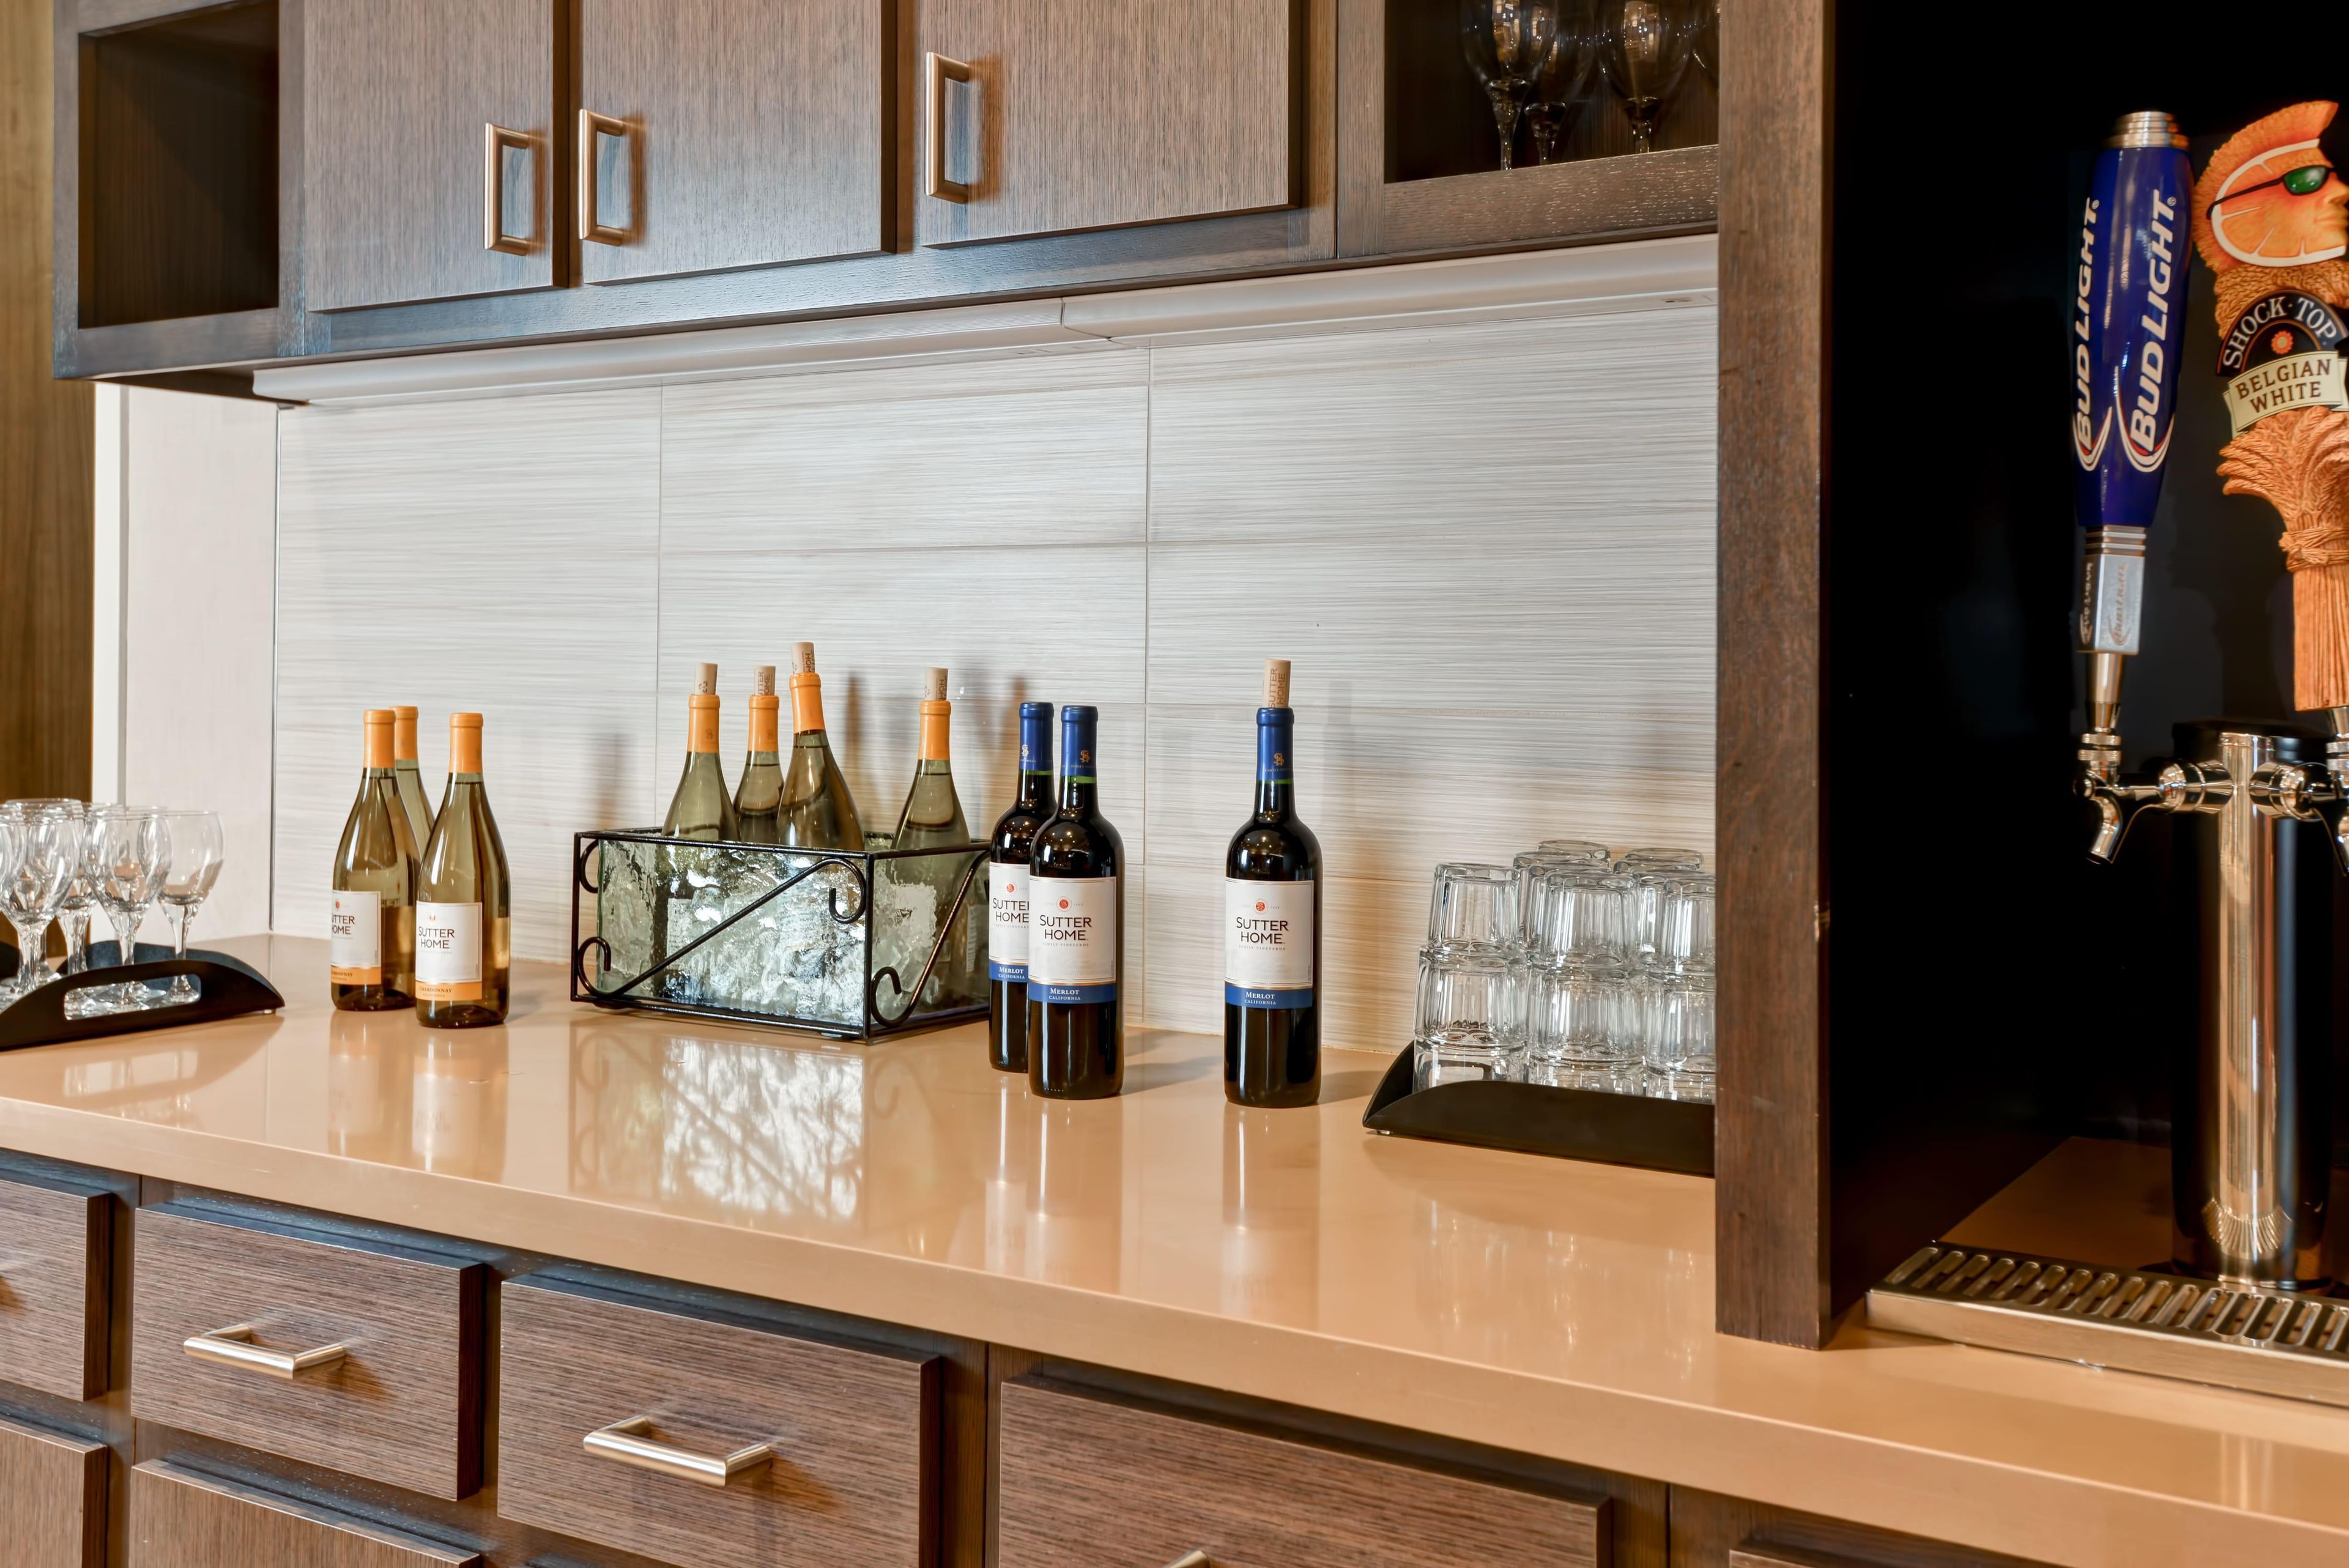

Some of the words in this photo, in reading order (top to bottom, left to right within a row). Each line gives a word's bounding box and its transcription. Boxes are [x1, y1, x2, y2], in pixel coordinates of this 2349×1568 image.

[2075, 197, 2098, 341] LIGHT
[2142, 189, 2174, 341] LIGHT
[2222, 296, 2287, 368] SHOCK
[2295, 297, 2337, 338] TOP
[2235, 359, 2331, 400] BELGIAN
[2077, 344, 2092, 450] BUD
[2131, 341, 2164, 451] BUD
[2249, 381, 2321, 413] WHITE
[1277, 673, 1285, 705] HOME
[993, 897, 1030, 911] SUTTE
[332, 915, 355, 924] UTTER
[995, 911, 1030, 923] HOME
[1040, 915, 1092, 927] SUTTER
[1236, 916, 1290, 931] SUTTER
[418, 926, 455, 938] SUTTER
[1044, 929, 1086, 941] HOME
[1241, 932, 1282, 944] HOME
[420, 938, 450, 949] HOME
